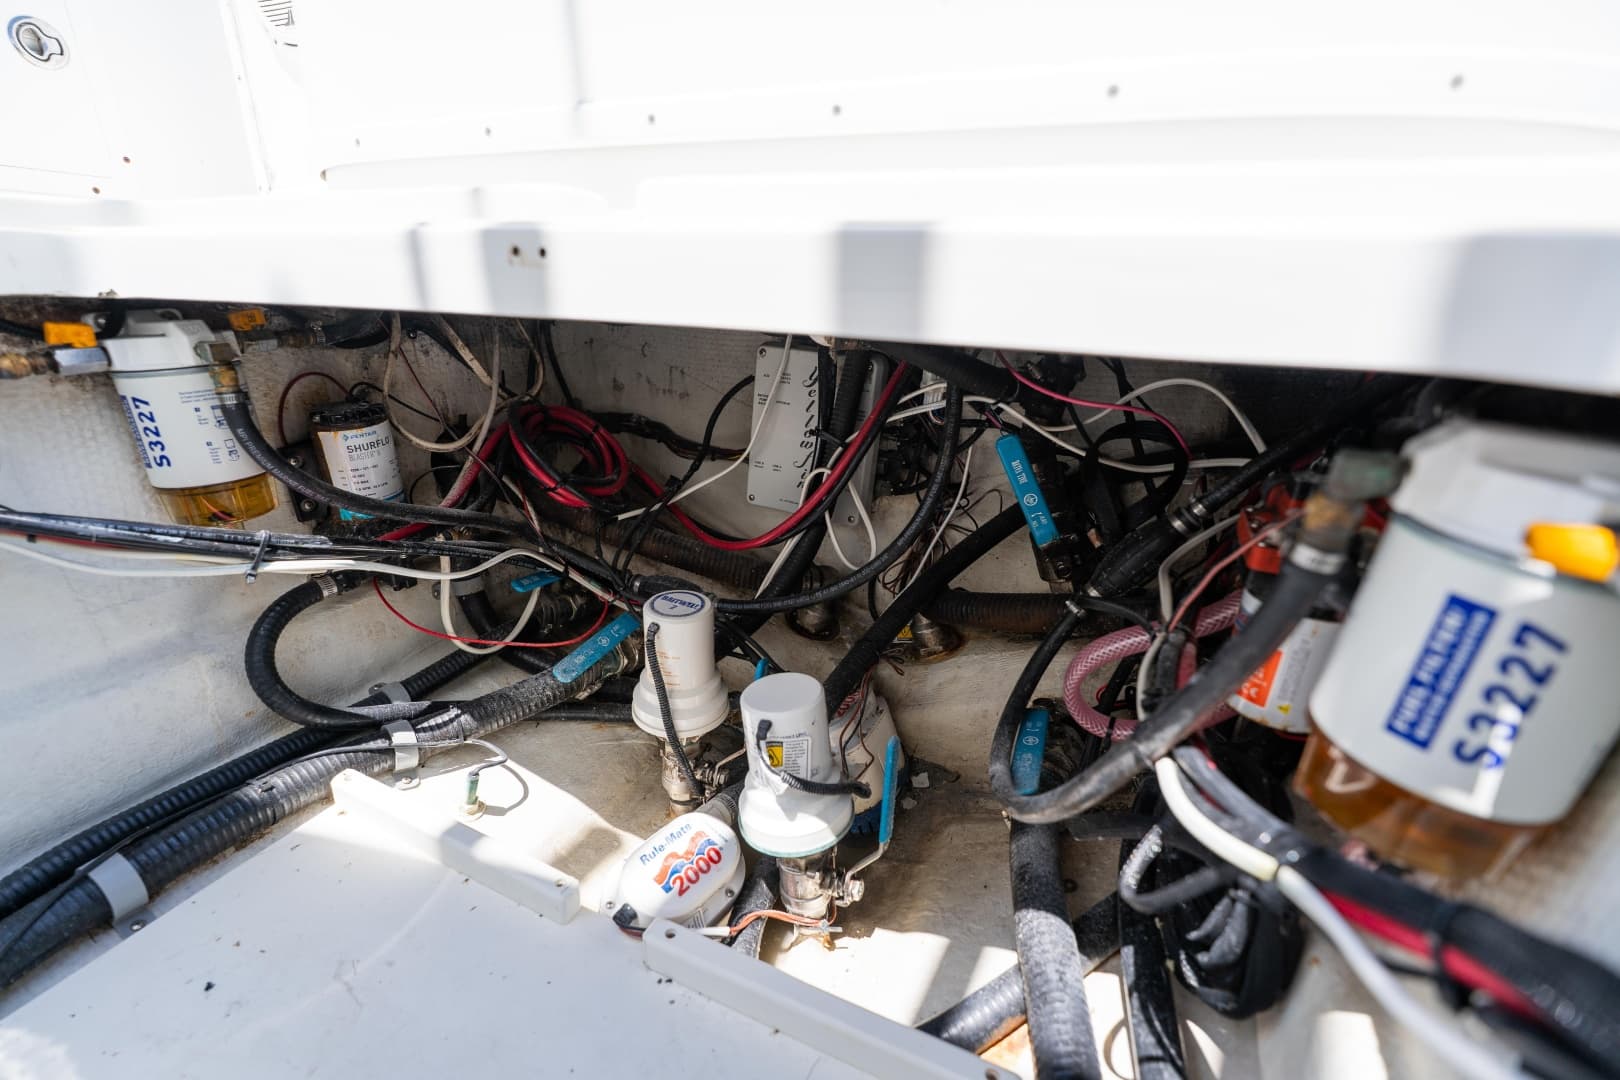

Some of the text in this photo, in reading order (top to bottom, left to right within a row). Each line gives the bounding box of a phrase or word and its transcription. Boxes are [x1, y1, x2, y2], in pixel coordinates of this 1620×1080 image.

[131, 396, 171, 467] S3227
[346, 436, 390, 454] SHURFLO
[350, 430, 377, 440] PENTAIR
[1453, 621, 1570, 769] S3227
[639, 823, 692, 866] Rule-Mate
[671, 846, 722, 897] 2000
